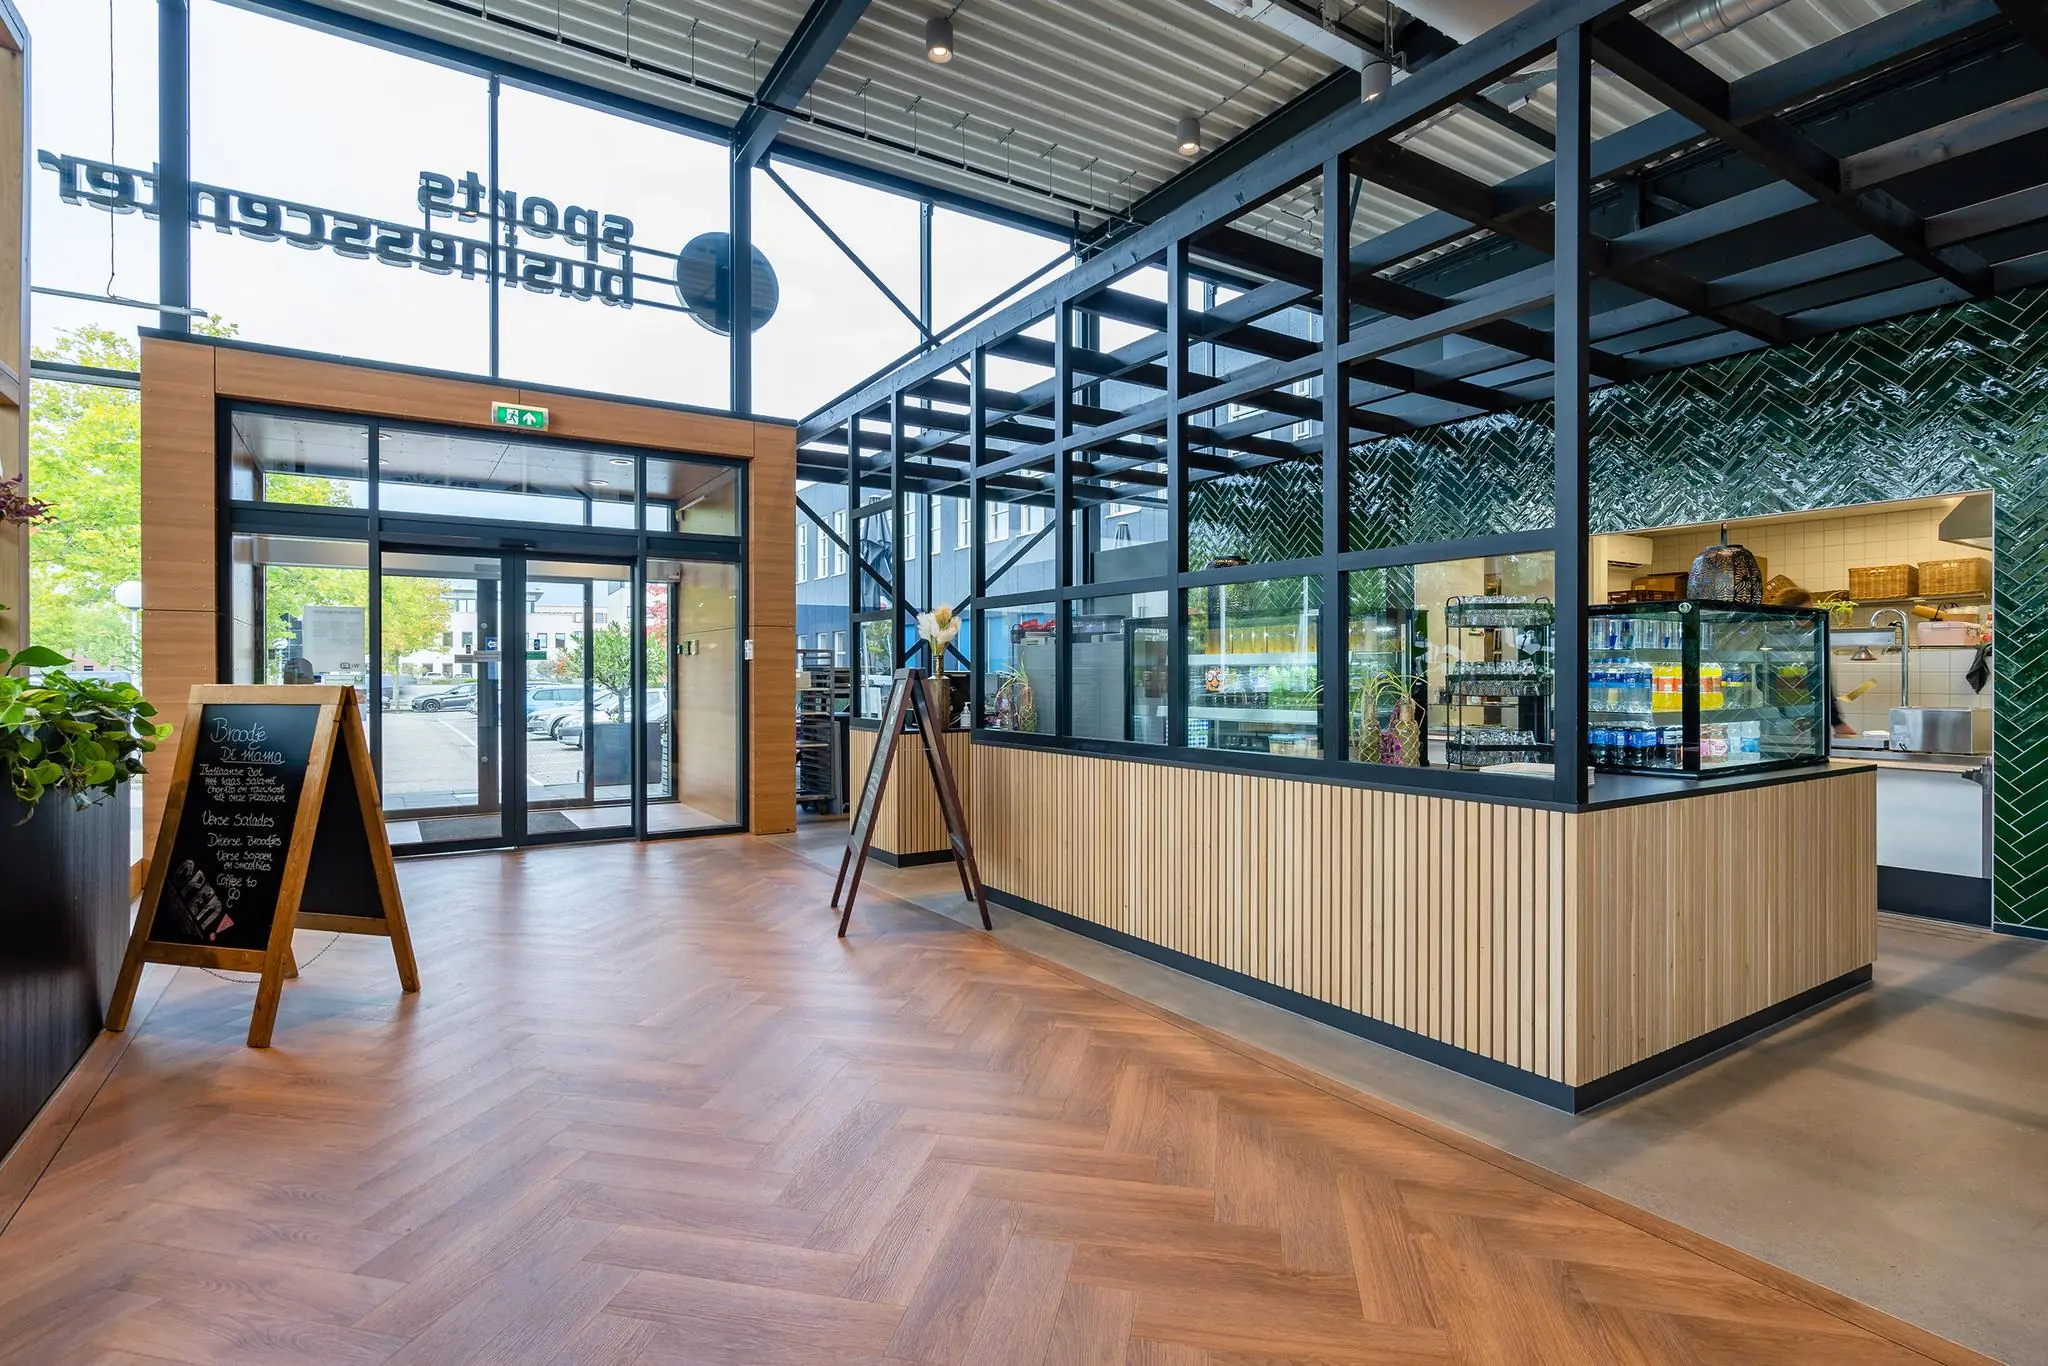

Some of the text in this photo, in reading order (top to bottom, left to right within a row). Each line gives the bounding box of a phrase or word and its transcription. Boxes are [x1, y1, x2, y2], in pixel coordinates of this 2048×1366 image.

[210, 717, 268, 750] Broodje
[220, 746, 237, 761] Di
[199, 763, 264, 777] Italiaanse Bol
[202, 809, 275, 828] Verse Salades
[207, 832, 282, 848] Diverse Broodjes
[216, 850, 240, 861] Verse
[223, 861, 272, 872] en smoothies
[216, 873, 258, 888] Coffee to
